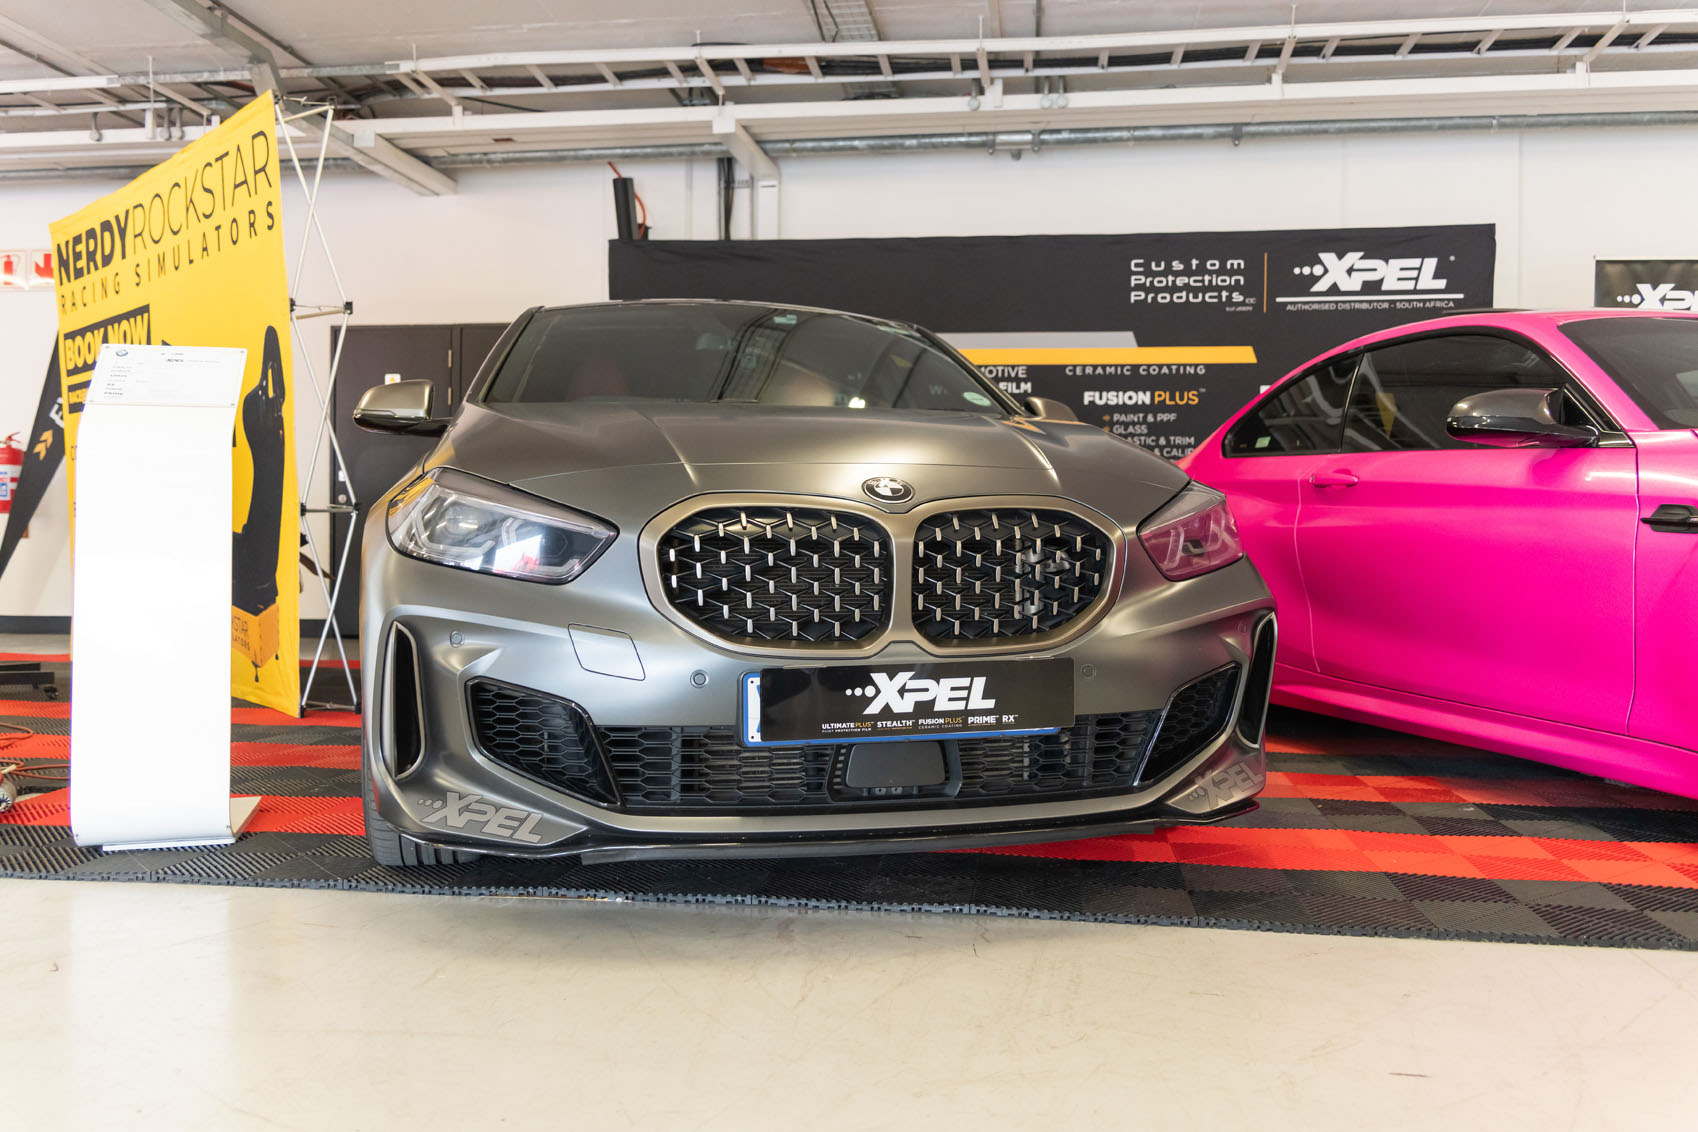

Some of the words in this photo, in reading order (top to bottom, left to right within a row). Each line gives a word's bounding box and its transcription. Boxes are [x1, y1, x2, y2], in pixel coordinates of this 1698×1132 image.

[56, 131, 273, 286] NERDYROCKSTAR
[60, 272, 121, 316] RACING
[135, 200, 275, 287] SIMULATORS
[1130, 258, 1245, 272] Custom
[1130, 274, 1245, 288] Protection
[1130, 290, 1244, 304] Products
[1286, 303, 1336, 311] AUTHORISED
[1338, 302, 1389, 310] DISTRIBUTOR
[1396, 301, 1423, 309] SOUTH
[1425, 300, 1455, 309] AFRICA
[1065, 366, 1132, 376] CERAMIC
[1139, 365, 1206, 375] COATING
[1083, 391, 1151, 406] FUSION
[1154, 390, 1199, 405] PLUS
[1113, 413, 1144, 423] PAINT
[1147, 413, 1154, 422] &
[1156, 413, 1177, 422] PPF
[1113, 424, 1148, 434] GLASS
[1158, 436, 1166, 445] &
[1169, 436, 1195, 445] TRIM
[862, 671, 996, 715] XPEL
[877, 720, 913, 728] STEALTH
[968, 715, 996, 724] PRIME
[1002, 715, 1015, 723] RX
[1194, 760, 1265, 809] XPEL
[421, 791, 543, 844] XPEL
